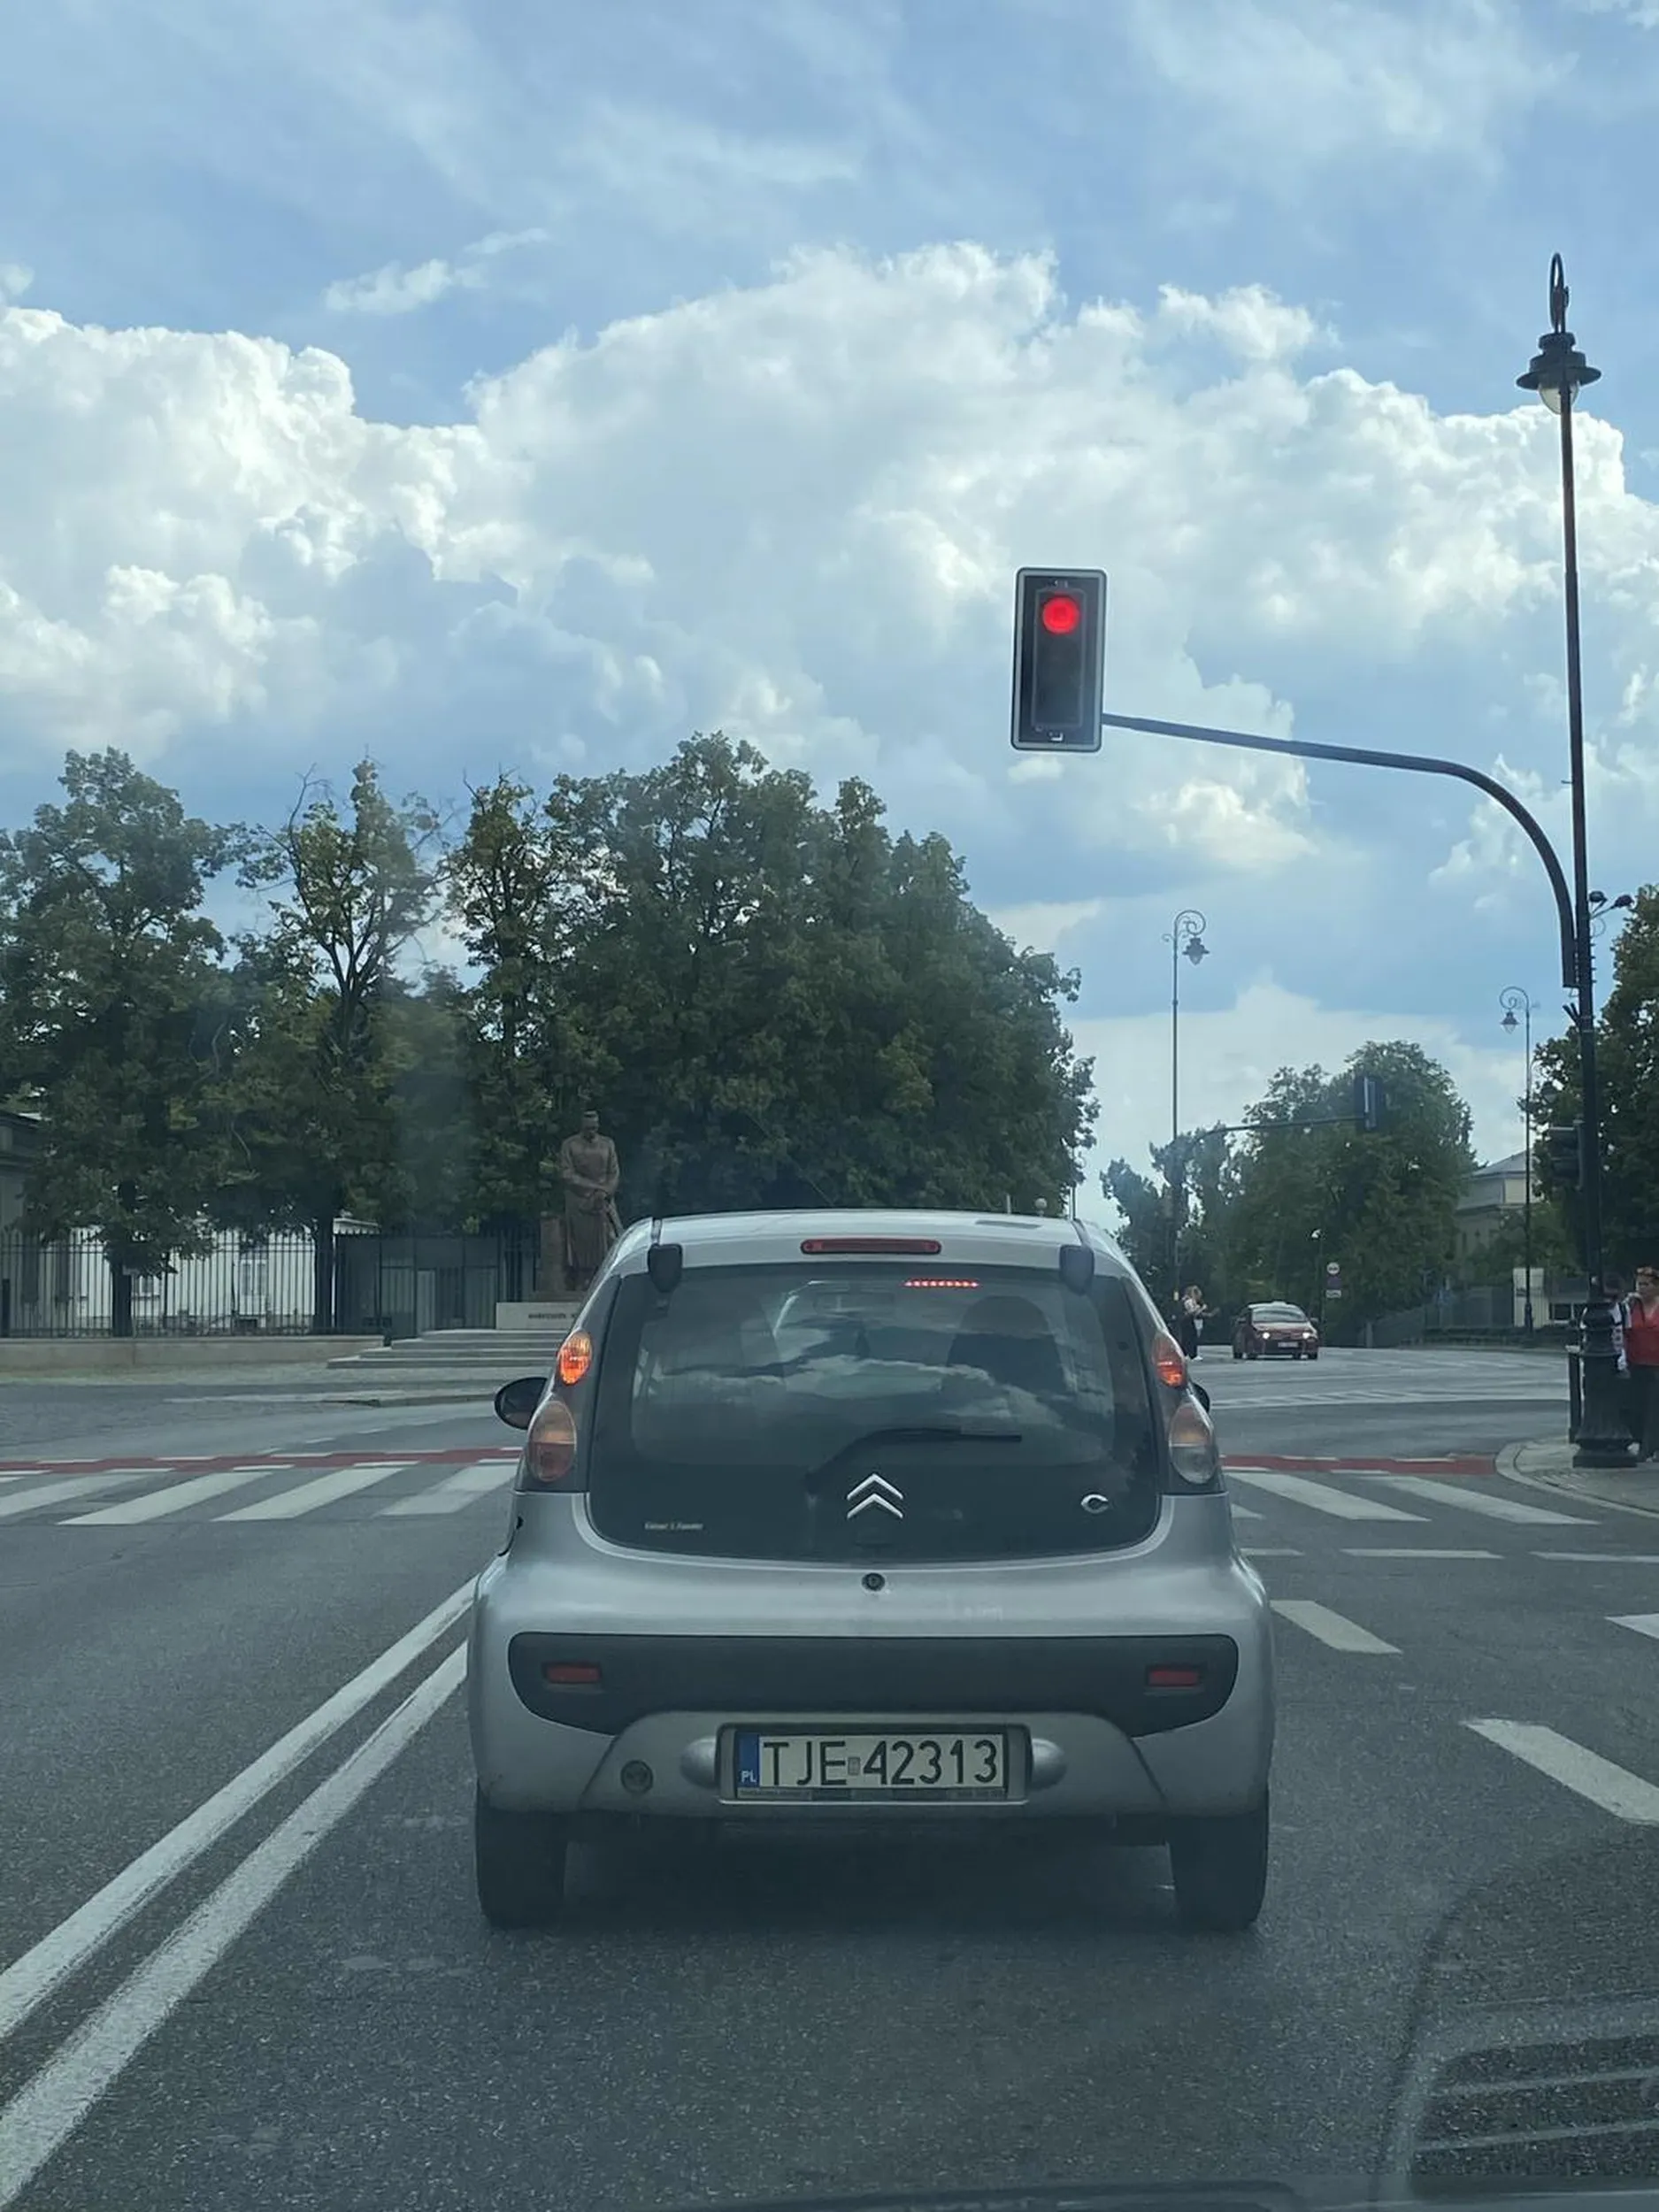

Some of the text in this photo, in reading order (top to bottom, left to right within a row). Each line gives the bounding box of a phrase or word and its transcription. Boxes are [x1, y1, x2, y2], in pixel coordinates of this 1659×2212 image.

[741, 1770, 757, 1783] PL
[763, 1740, 998, 1786] TJE 42313
